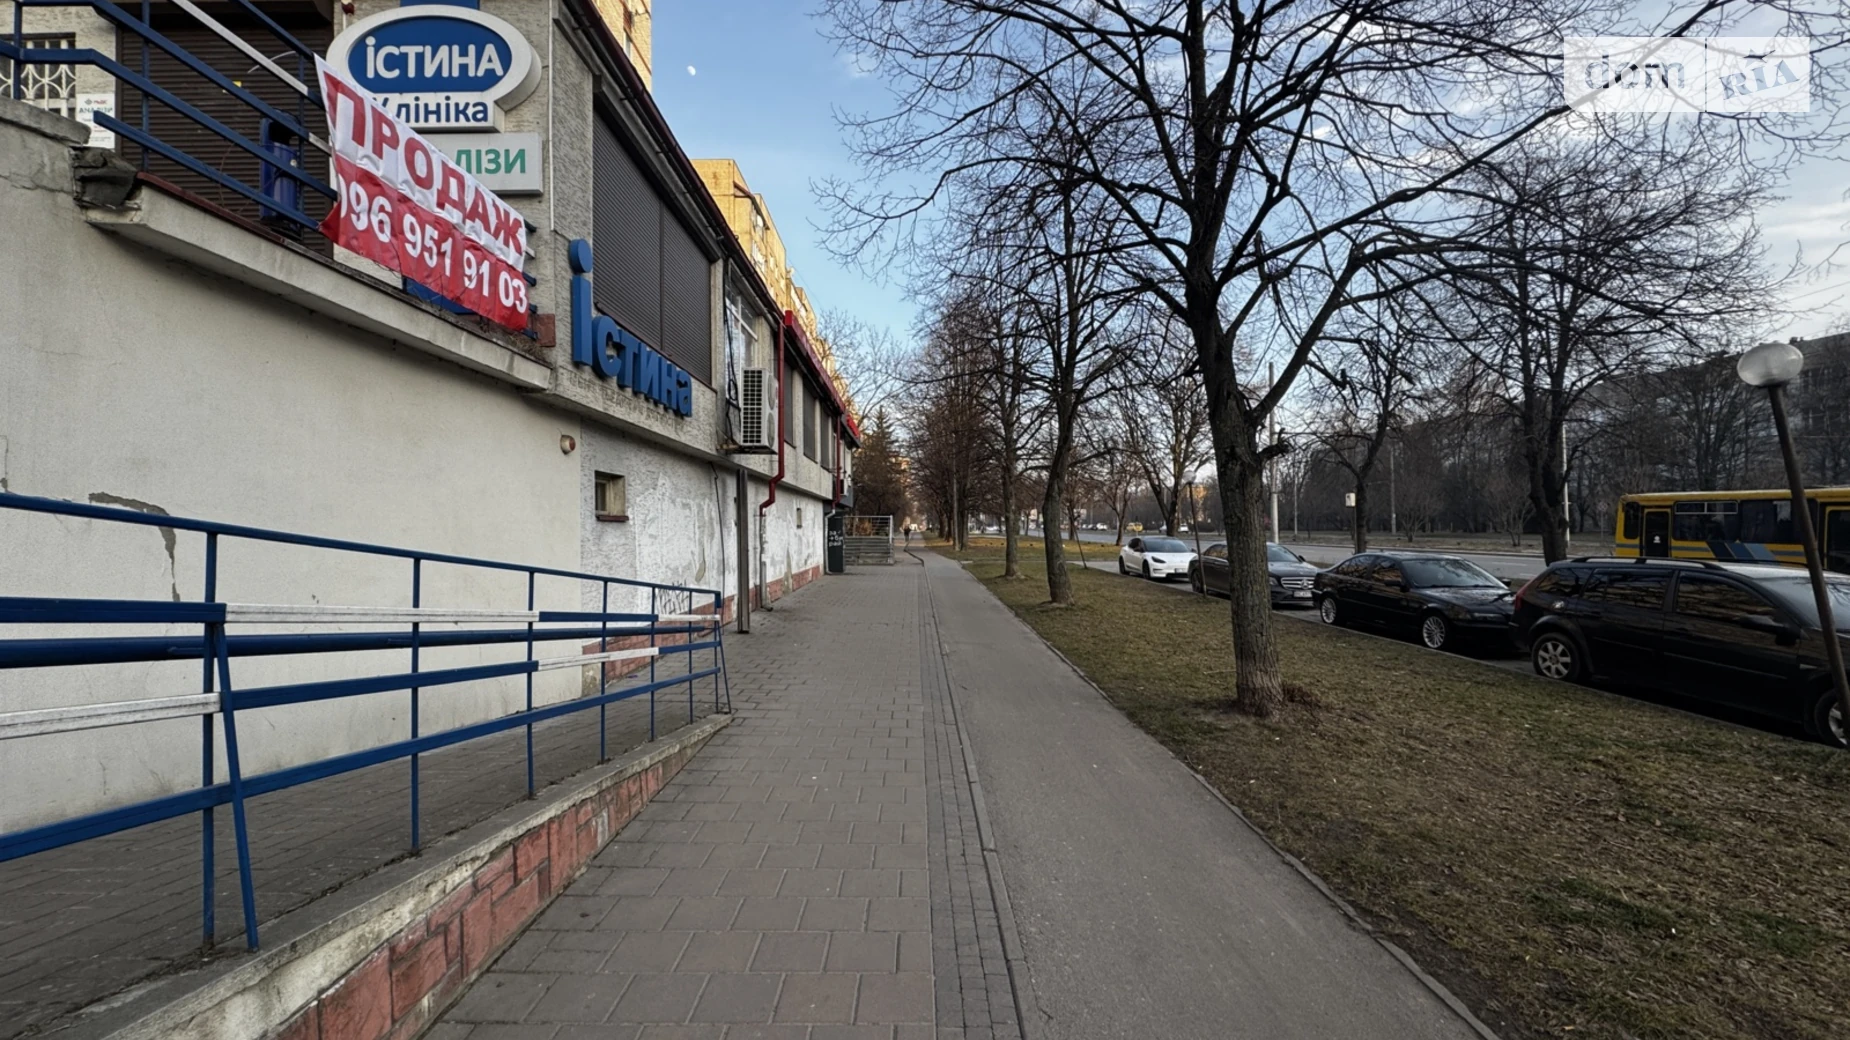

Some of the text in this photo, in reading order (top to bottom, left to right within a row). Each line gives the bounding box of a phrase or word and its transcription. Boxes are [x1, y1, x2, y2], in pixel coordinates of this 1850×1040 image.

[373, 95, 489, 124] лініка
[323, 70, 524, 258] ПРОДАЖ
[454, 148, 527, 175] ЛІЗИ
[403, 214, 453, 277] 951
[463, 250, 490, 297] 91
[499, 271, 528, 313] 03
